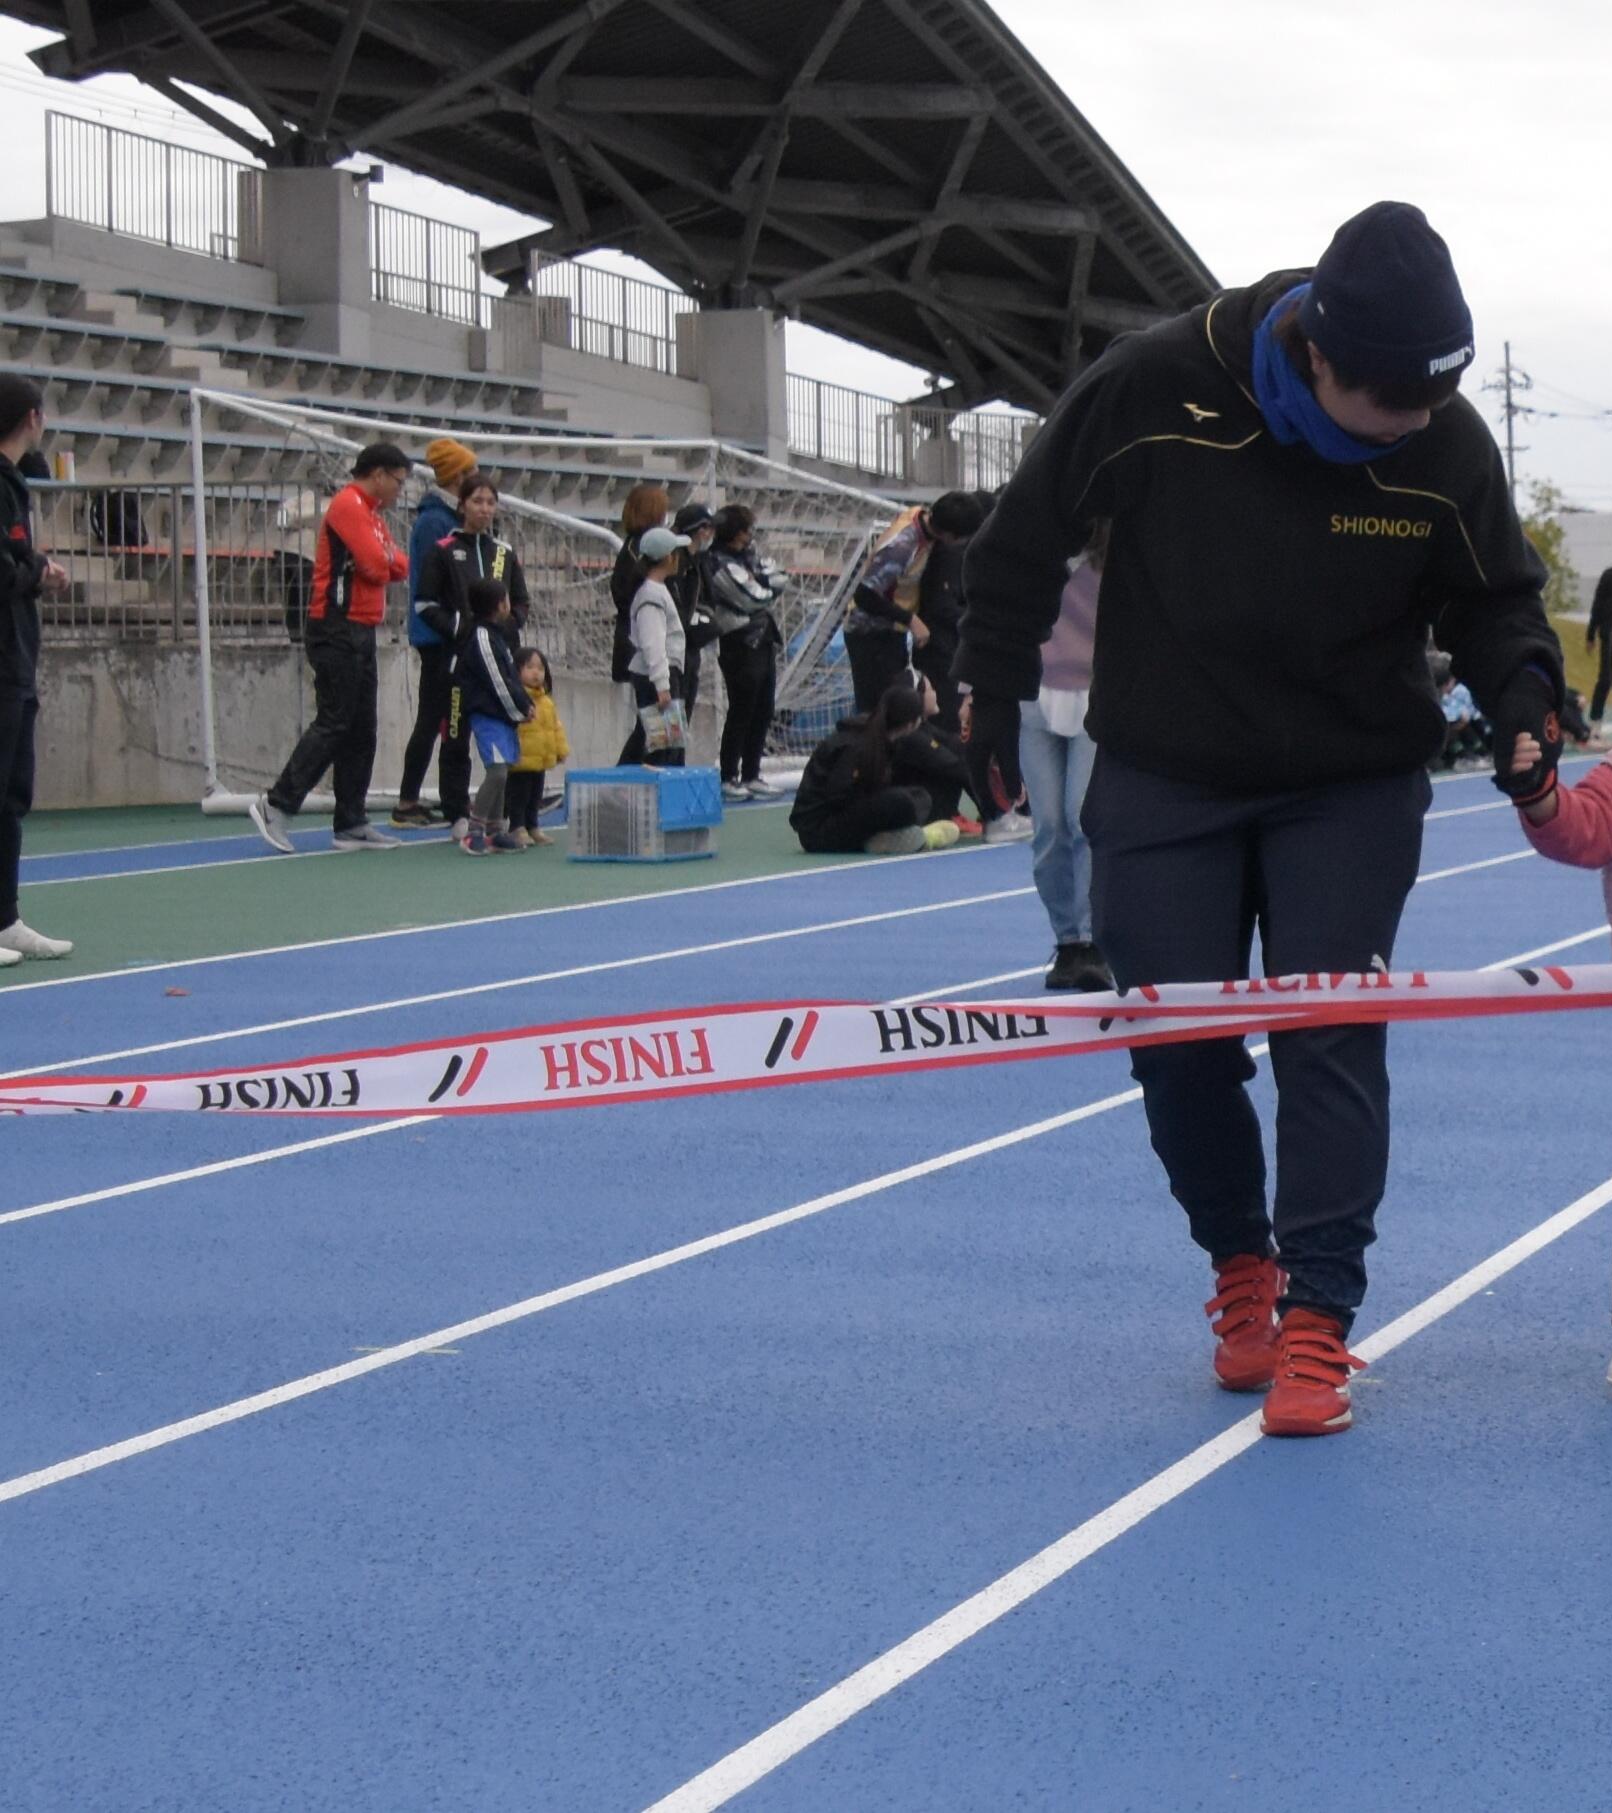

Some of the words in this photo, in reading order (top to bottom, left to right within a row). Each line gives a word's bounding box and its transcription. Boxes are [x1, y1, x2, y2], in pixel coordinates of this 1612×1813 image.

[1330, 514, 1433, 537] SHIONOGI
[449, 686, 461, 739] umbro
[539, 1027, 715, 1091] FINISH
